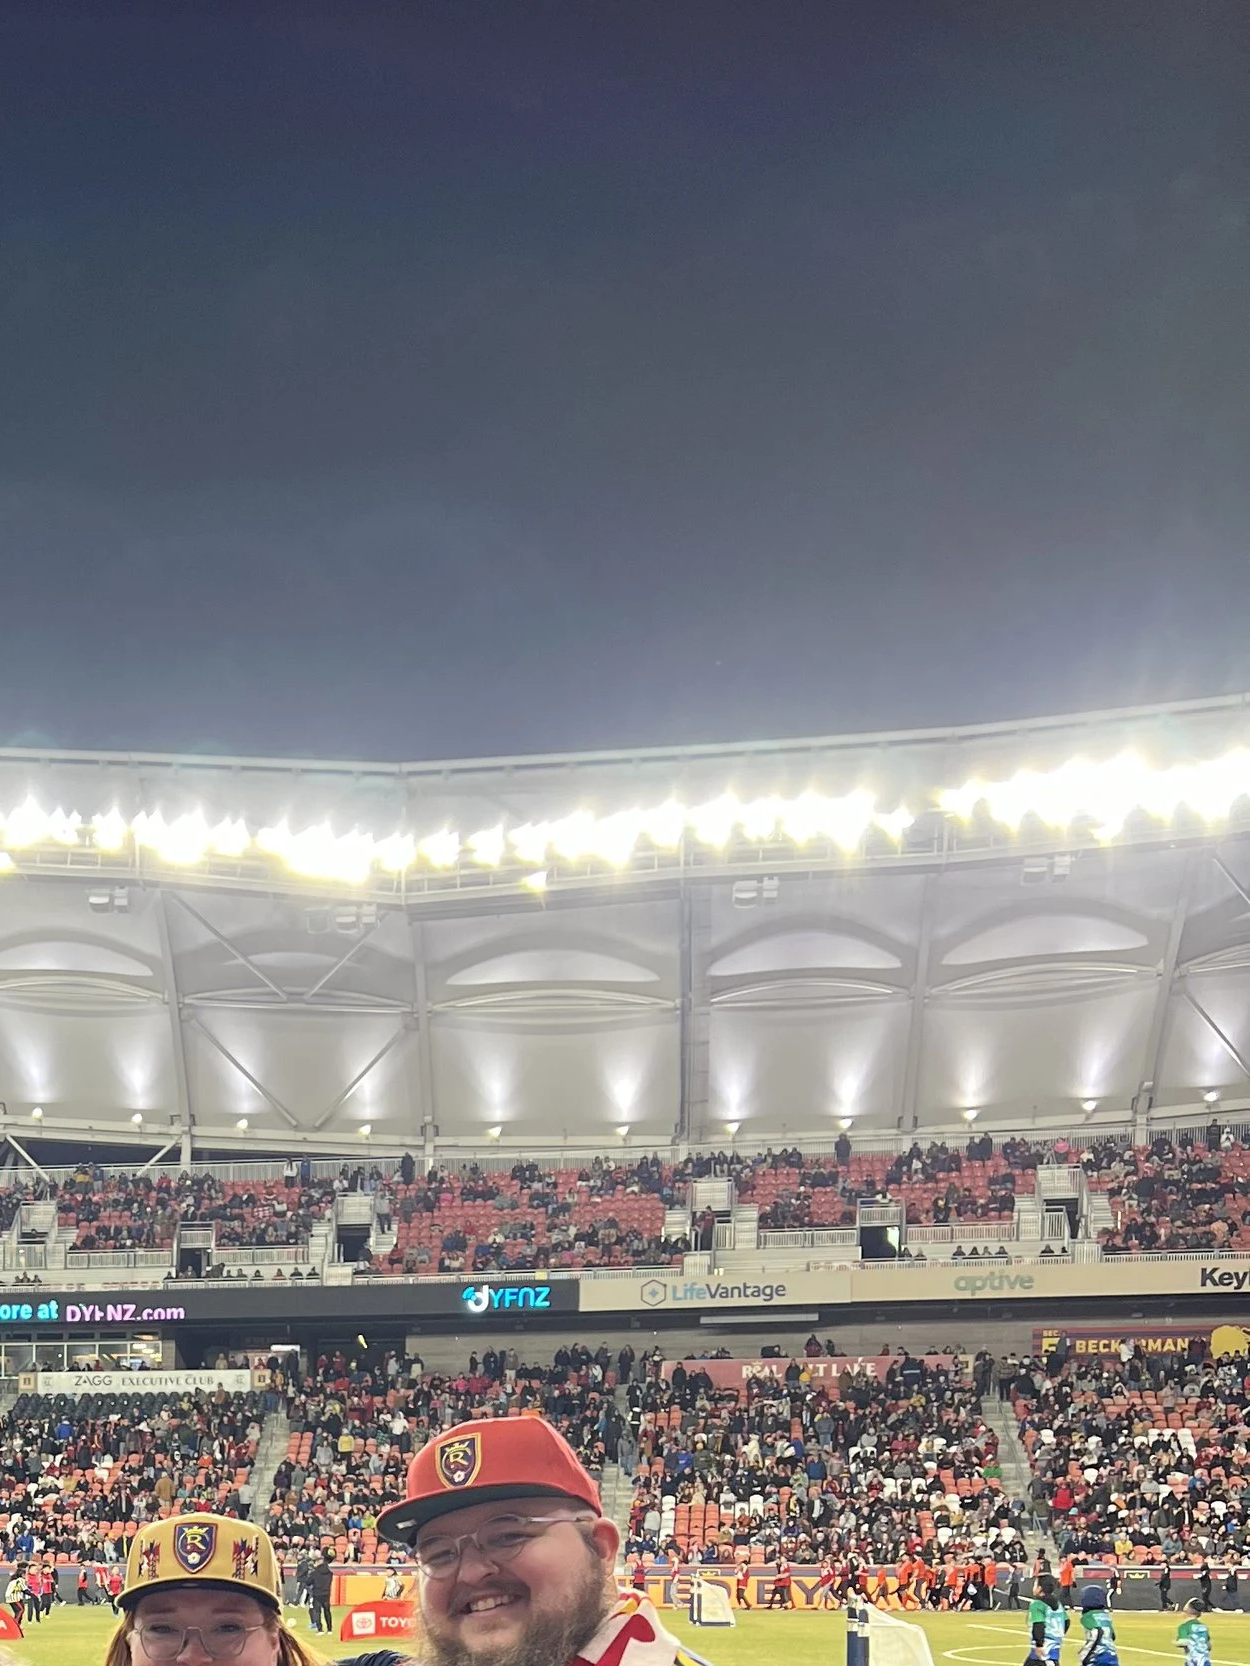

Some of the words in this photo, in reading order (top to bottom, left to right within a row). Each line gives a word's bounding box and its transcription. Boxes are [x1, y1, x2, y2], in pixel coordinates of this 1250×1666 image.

[953, 1270, 1036, 1296] aptive
[1200, 1267, 1250, 1291] Key
[671, 1281, 787, 1302] LifeVantage
[36, 1299, 59, 1320] at
[1075, 1337, 1190, 1354] BECKMAN
[74, 1375, 113, 1387] ZAGG
[121, 1376, 183, 1387] EXECUTIVE
[184, 1375, 215, 1386] CLUB
